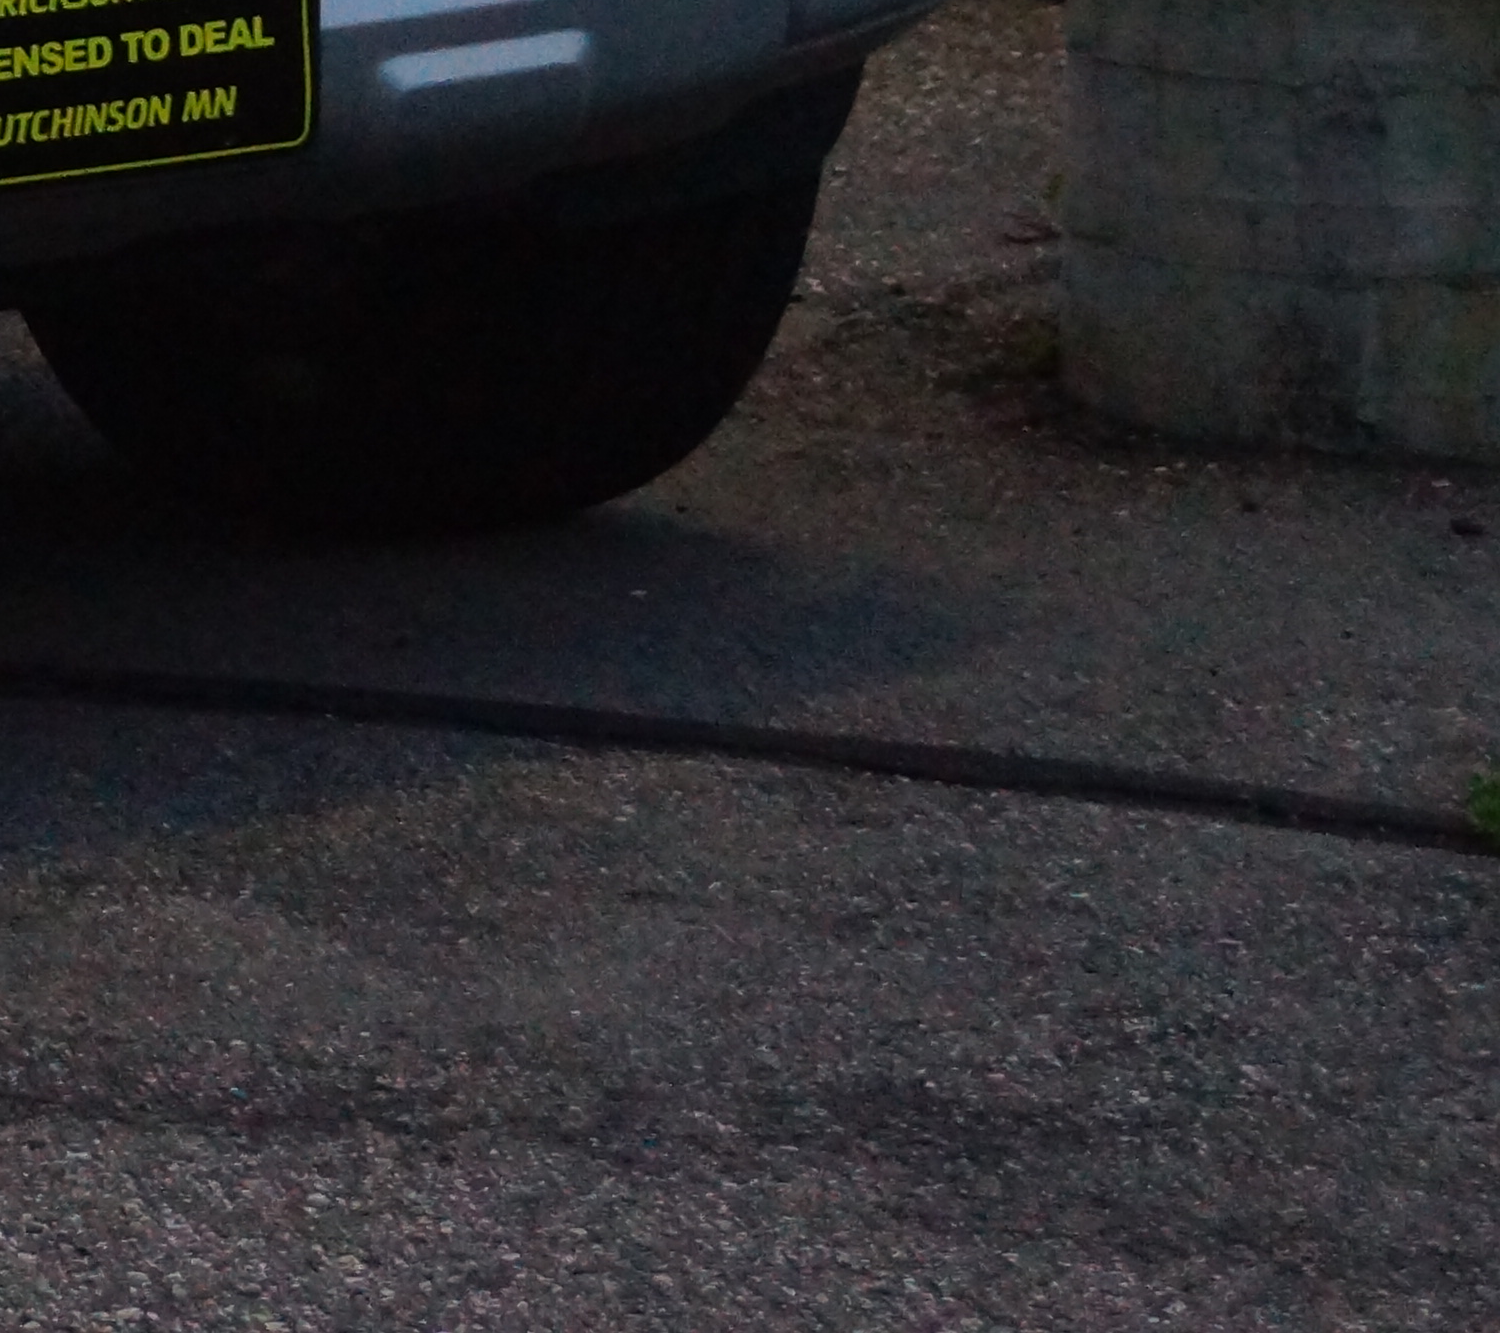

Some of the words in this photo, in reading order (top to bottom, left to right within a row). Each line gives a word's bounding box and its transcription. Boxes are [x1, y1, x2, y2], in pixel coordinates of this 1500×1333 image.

[120, 27, 170, 64] TO
[179, 15, 275, 57] DEAL
[181, 85, 238, 123] MN
